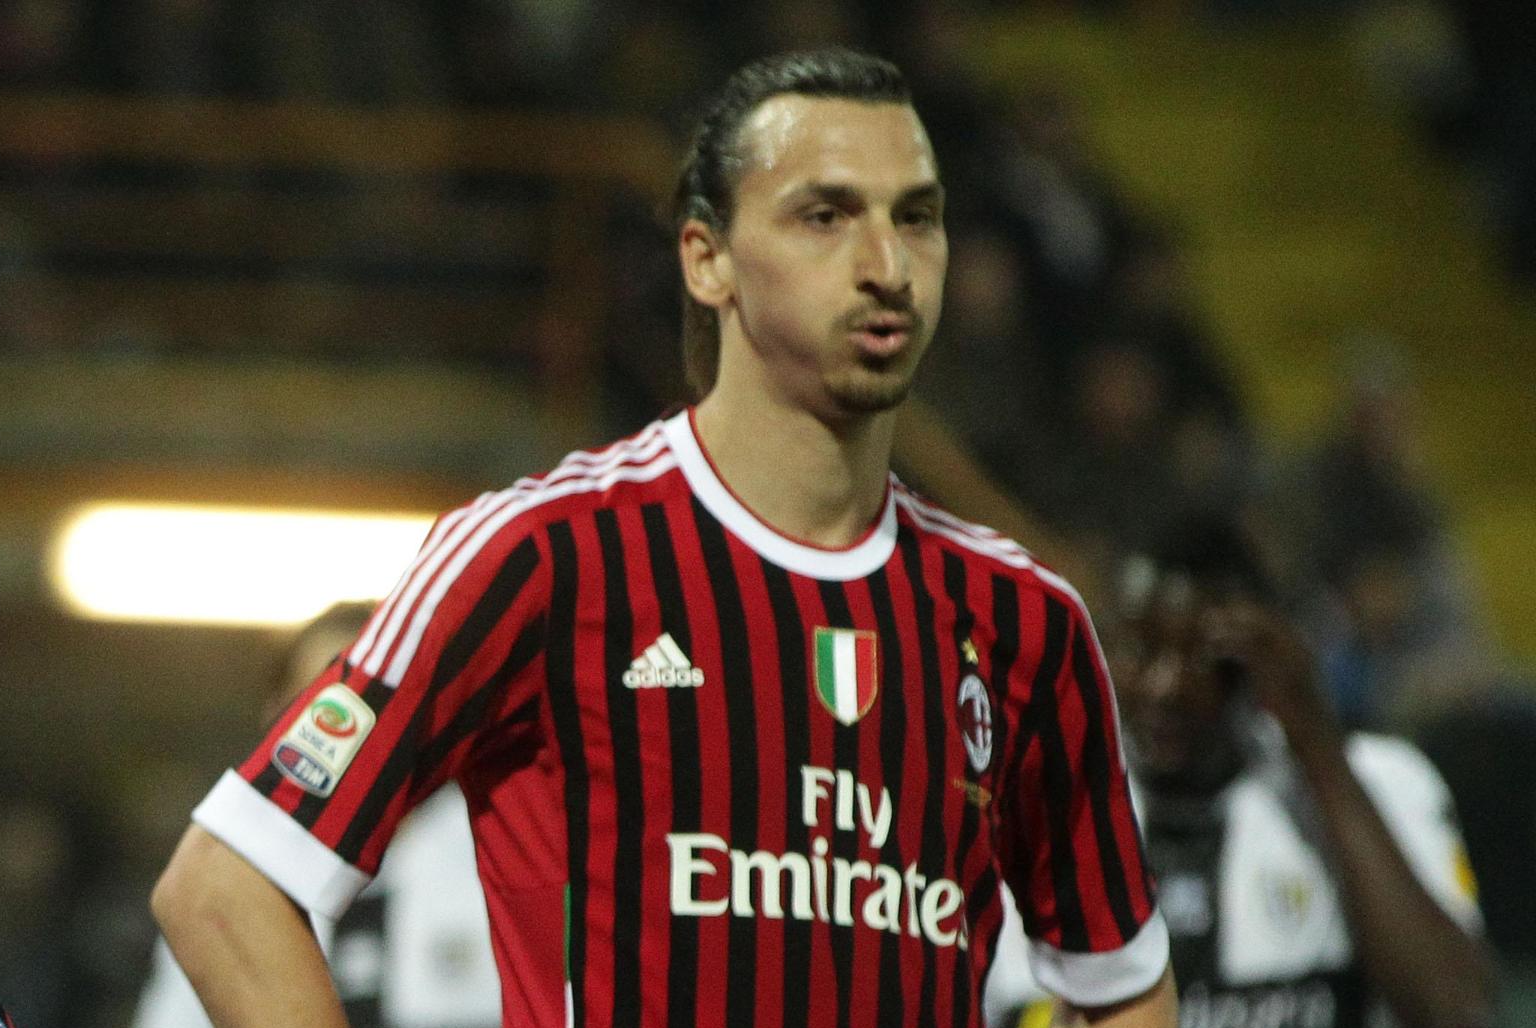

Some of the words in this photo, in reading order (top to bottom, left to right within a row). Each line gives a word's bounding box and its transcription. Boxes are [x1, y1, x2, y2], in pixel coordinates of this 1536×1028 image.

[622, 667, 705, 689] adidas
[800, 764, 893, 849] Fly
[665, 832, 968, 951] Emirate
